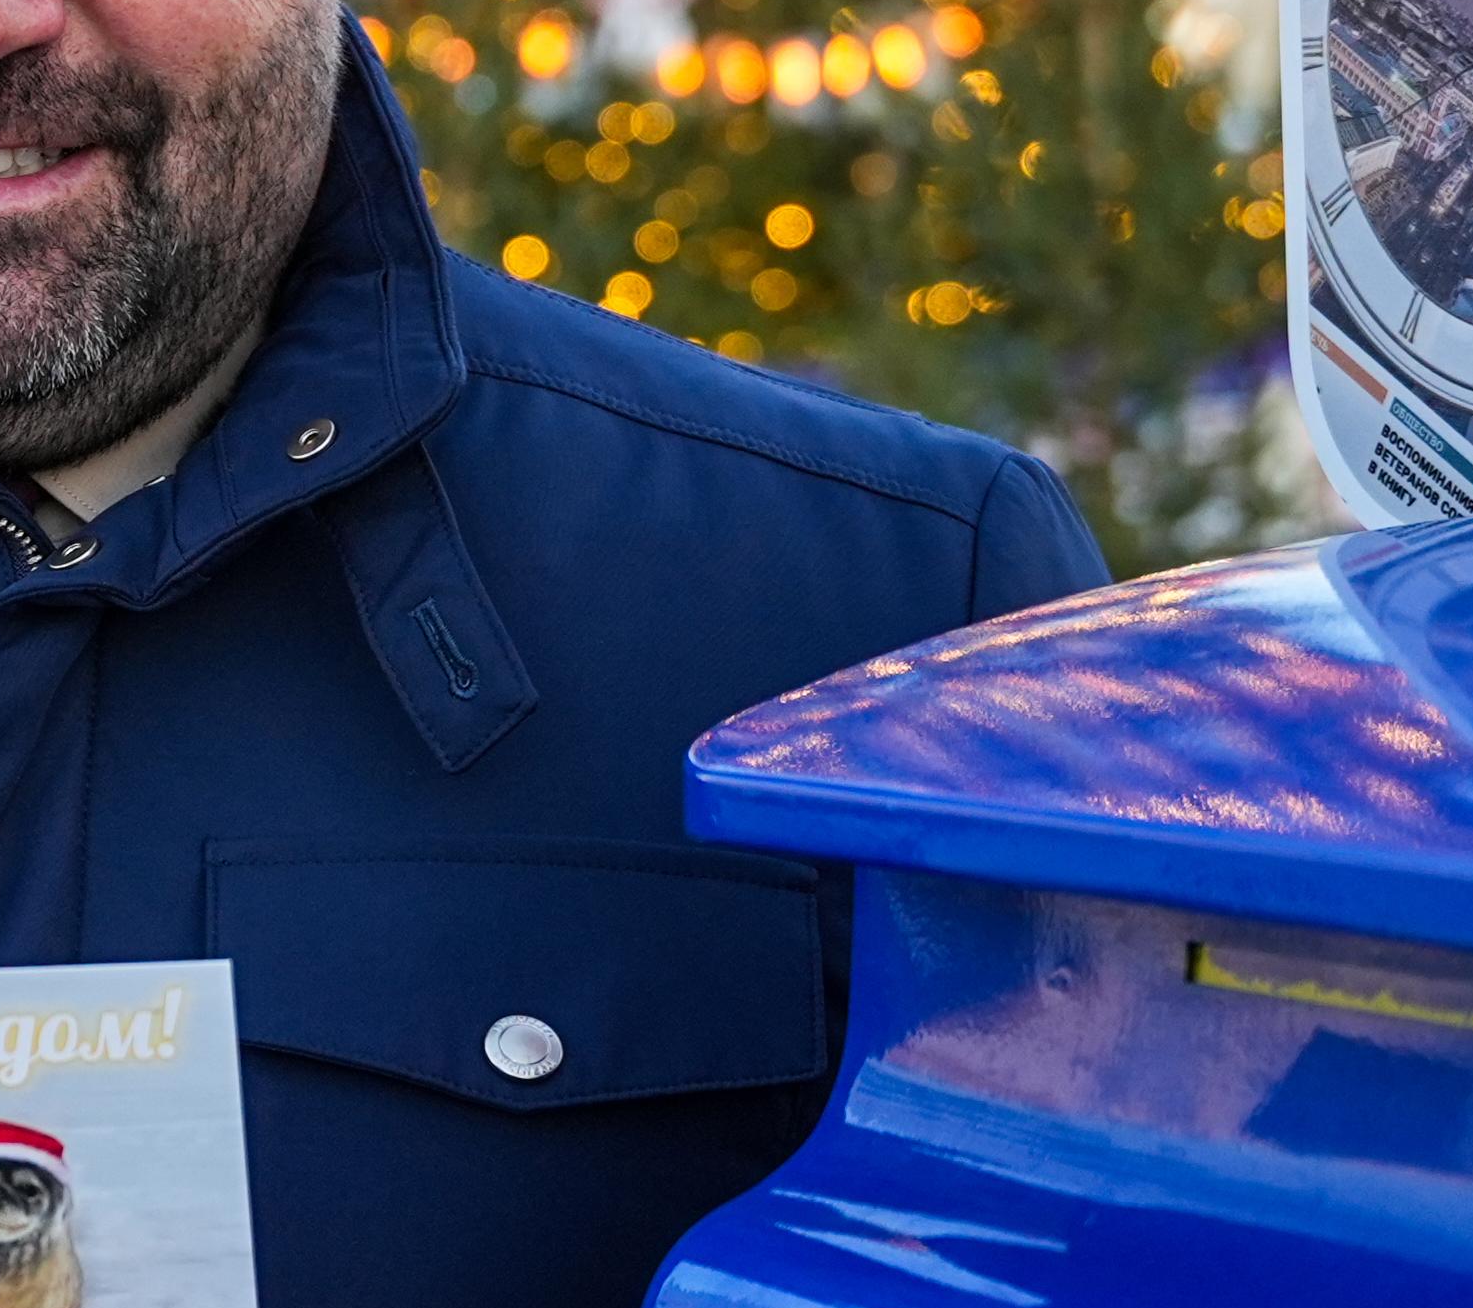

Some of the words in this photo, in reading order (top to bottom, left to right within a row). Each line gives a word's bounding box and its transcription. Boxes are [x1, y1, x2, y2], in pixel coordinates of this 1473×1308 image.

[1386, 401, 1448, 453] ОБЩЕСТВО
[1365, 460, 1380, 475] В
[1373, 470, 1417, 508] КНИГУ
[1368, 441, 1446, 506] ВЕТЕРАНОВ
